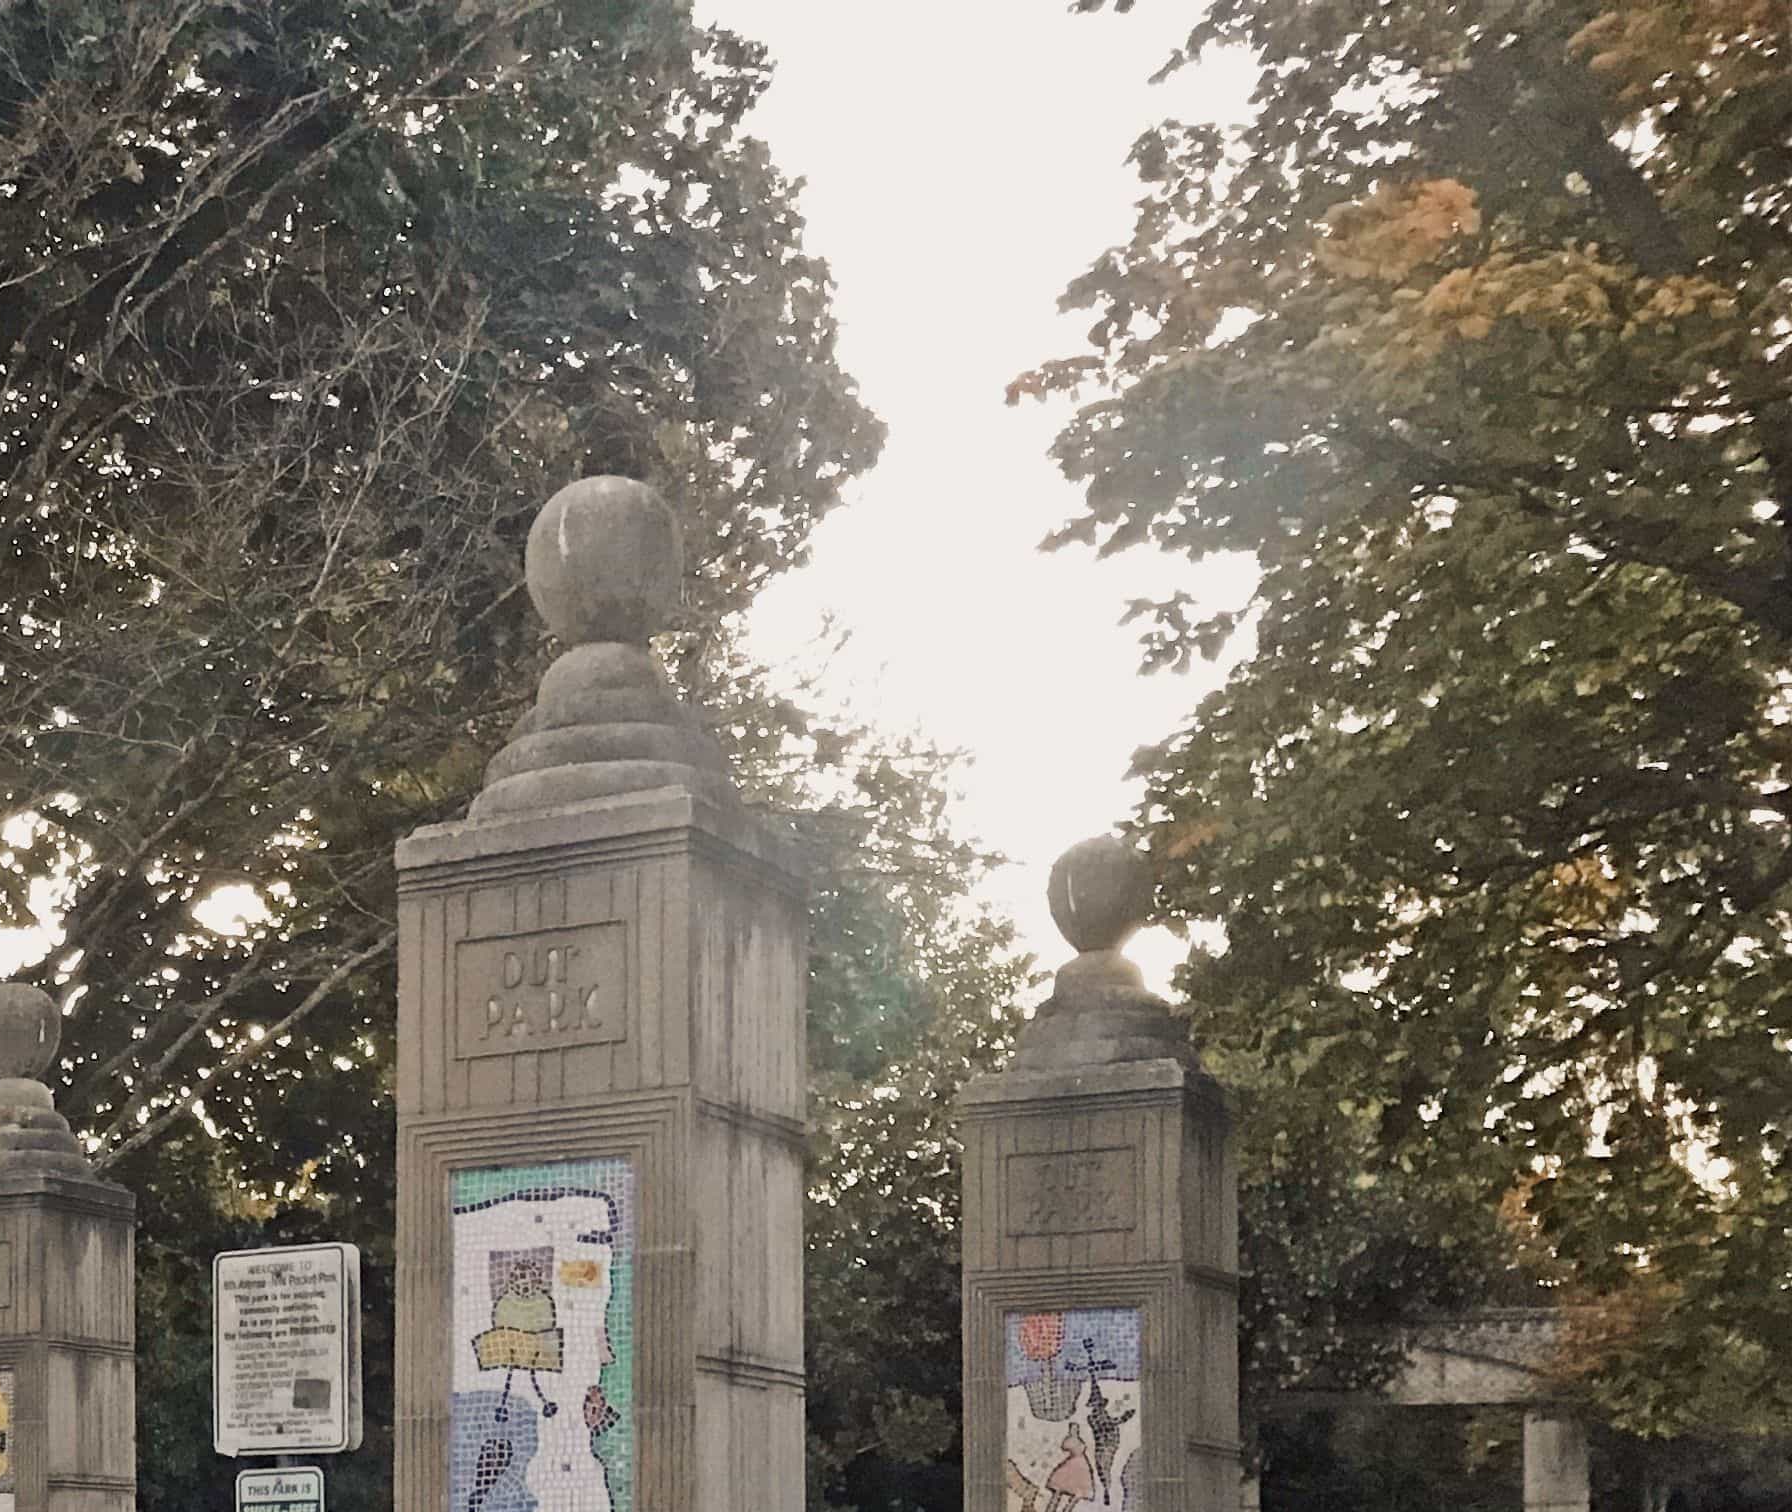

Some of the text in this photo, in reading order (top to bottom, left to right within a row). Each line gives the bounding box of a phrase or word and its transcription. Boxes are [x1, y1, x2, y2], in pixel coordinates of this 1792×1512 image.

[478, 983, 604, 1041] PARK
[248, 1260, 312, 1275] WELCOME TO
[248, 1483, 312, 1496] THIS PARK IS
